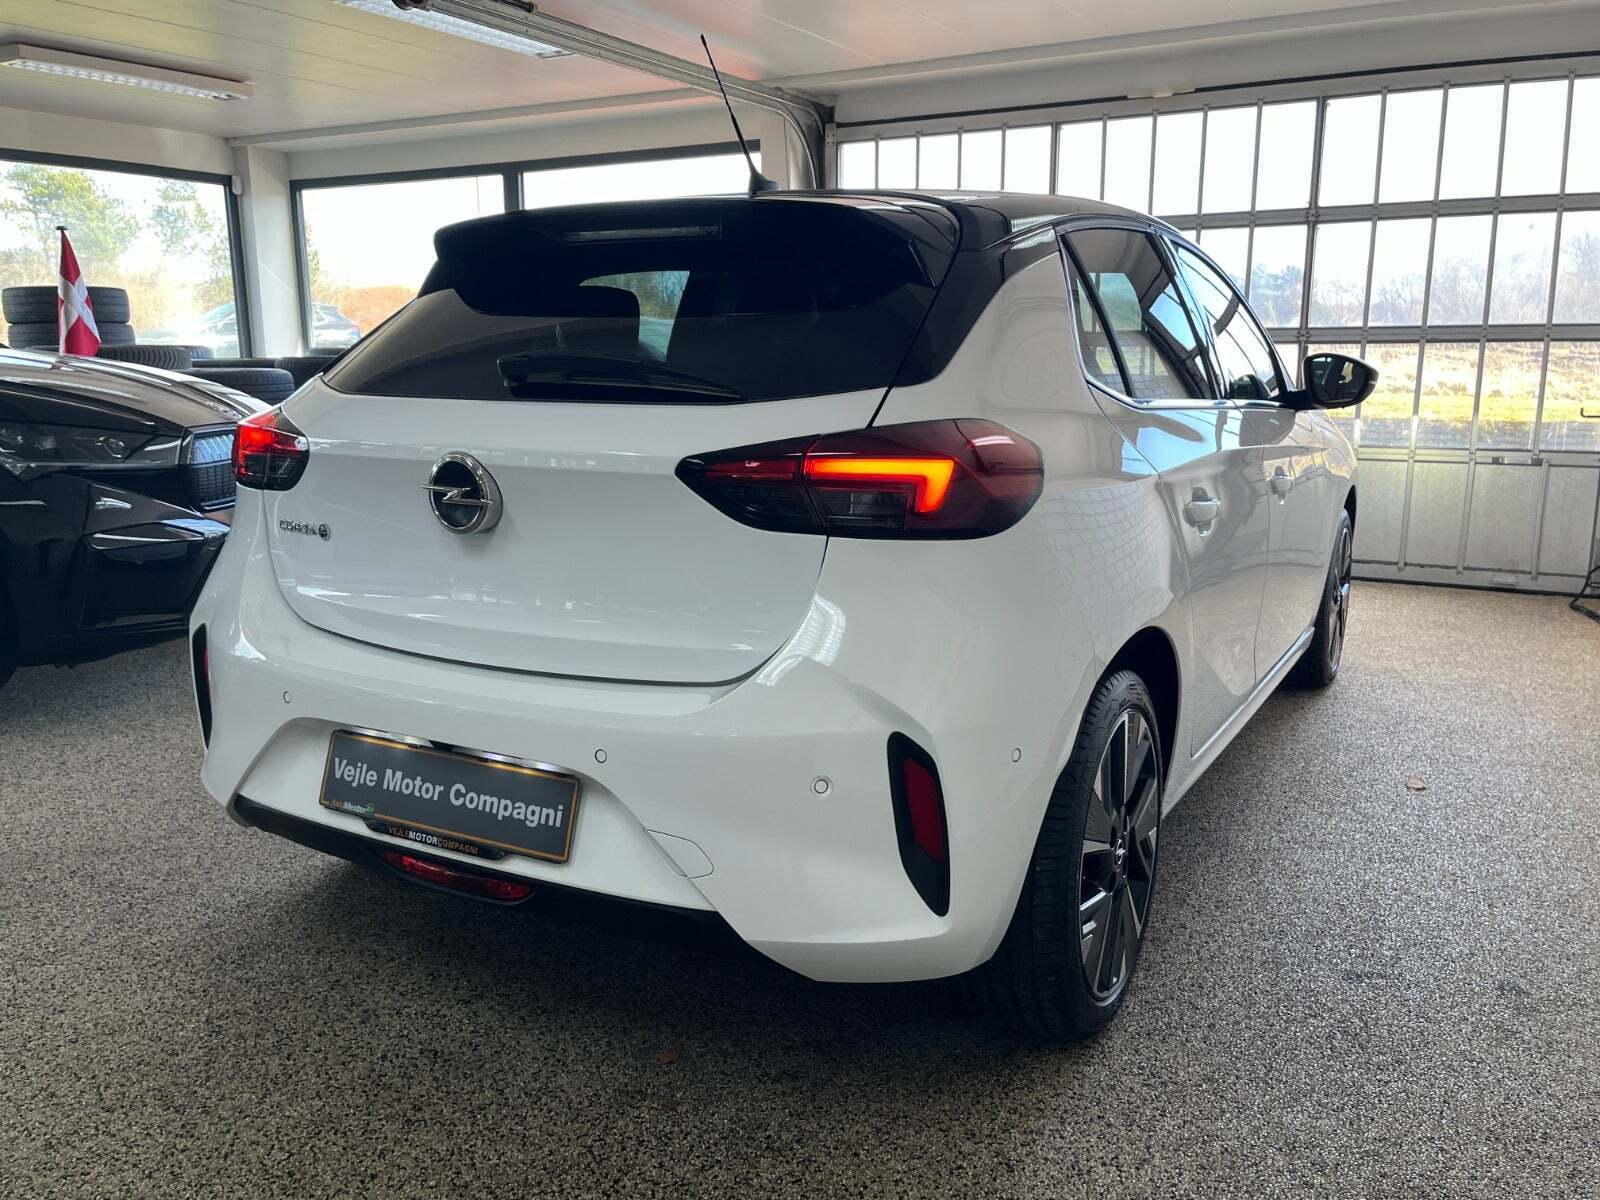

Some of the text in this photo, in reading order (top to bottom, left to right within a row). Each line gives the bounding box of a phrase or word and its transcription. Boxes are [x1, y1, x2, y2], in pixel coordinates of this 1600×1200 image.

[334, 757, 563, 828] Vejle Motor Compagni
